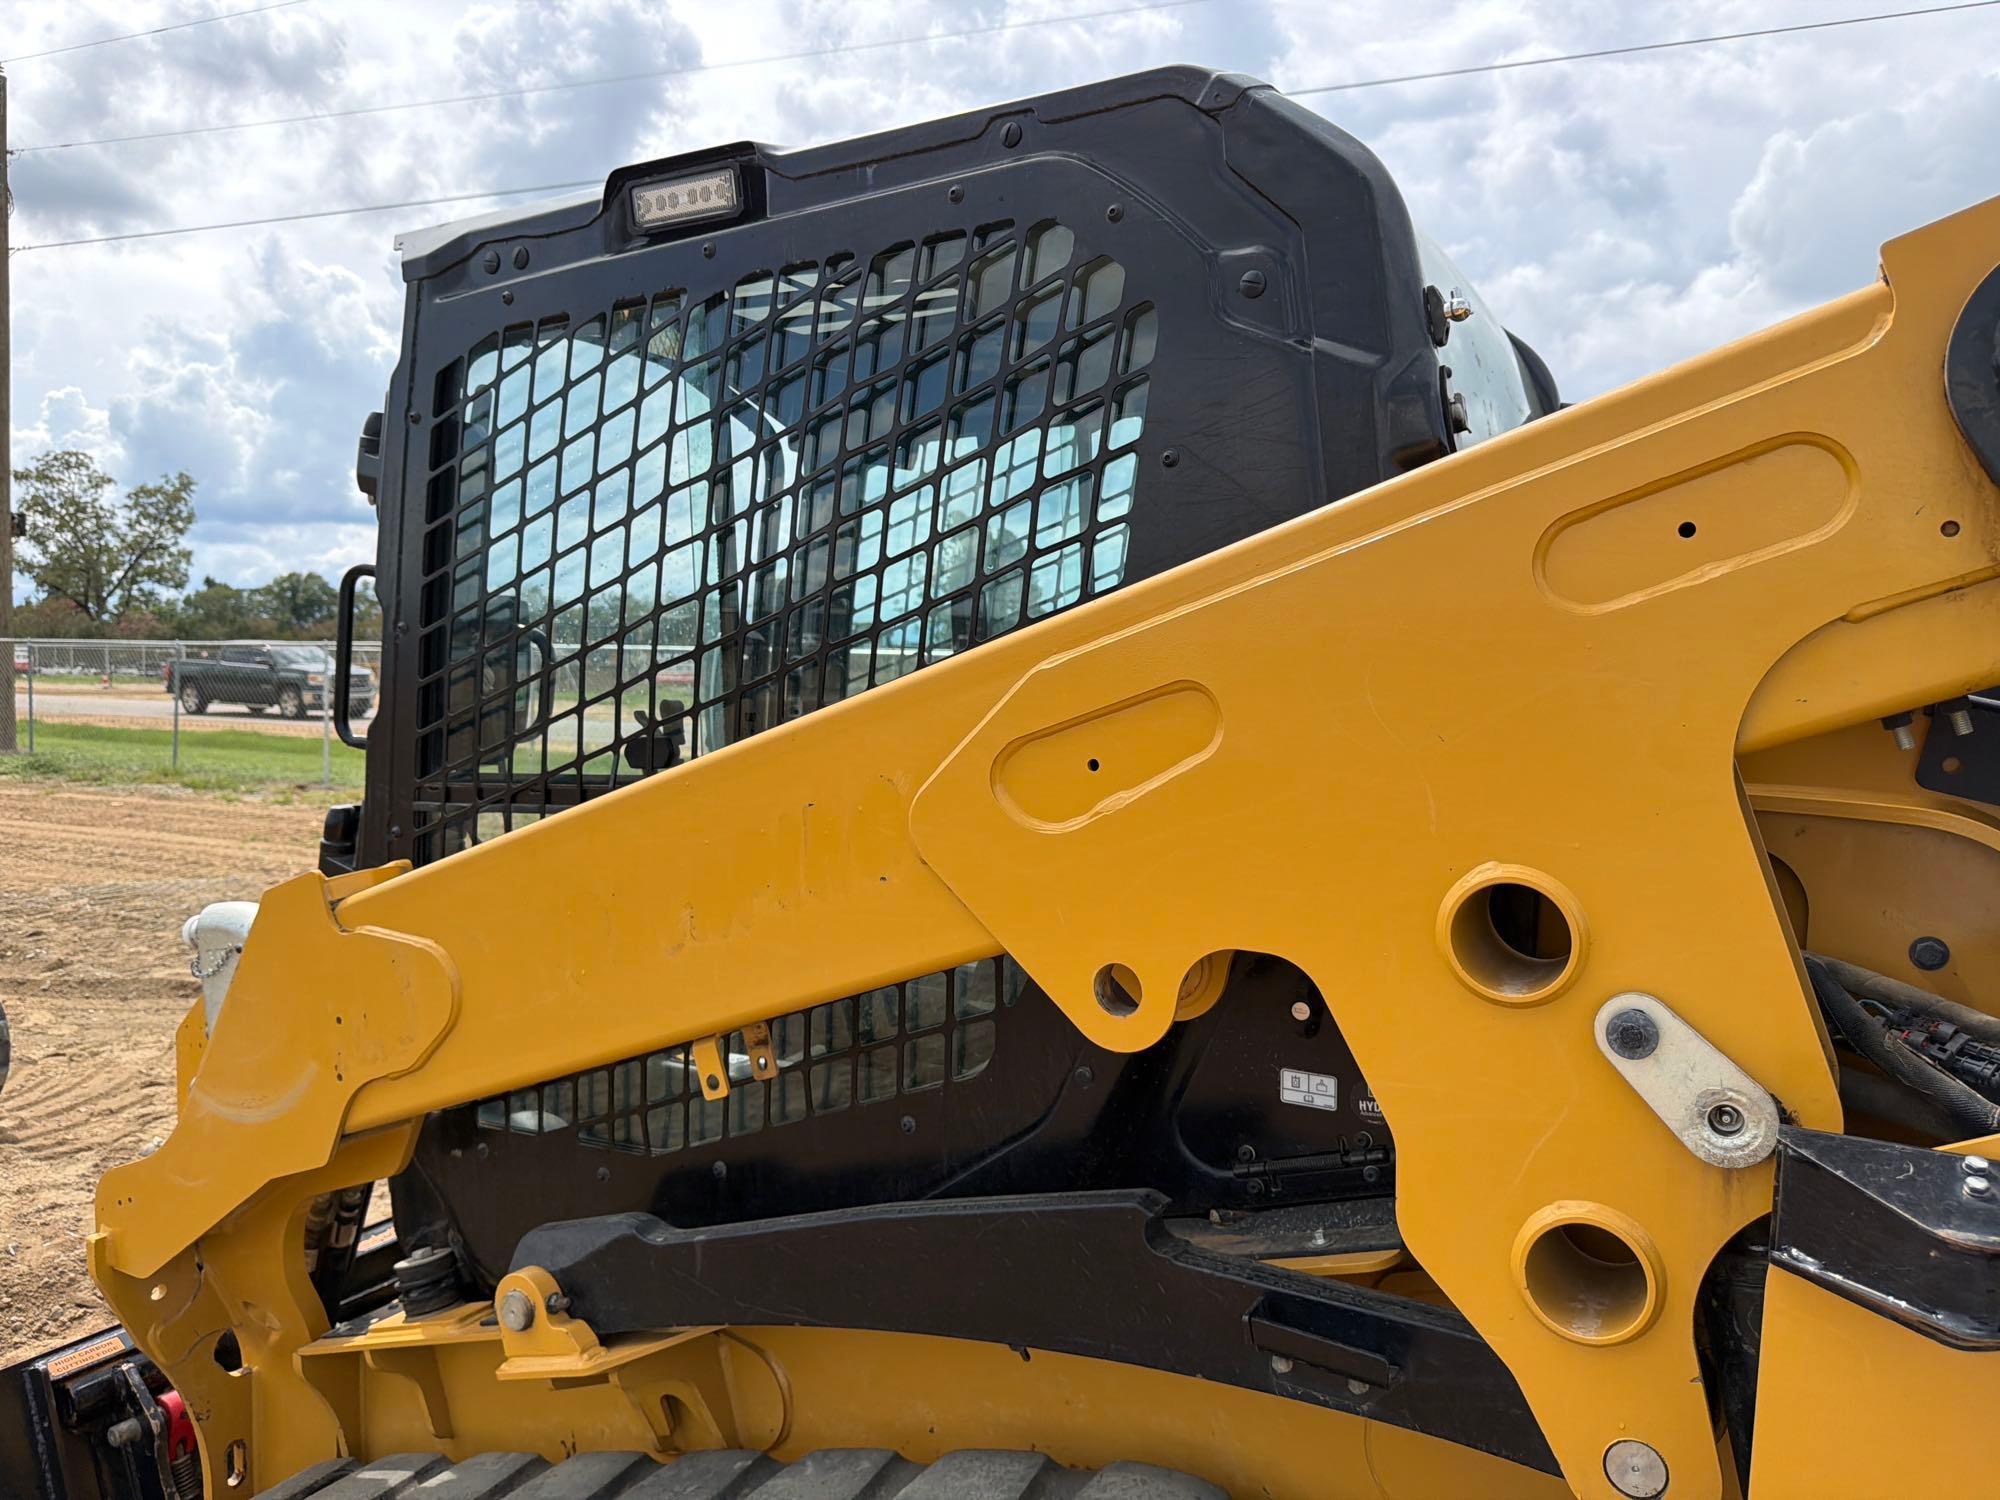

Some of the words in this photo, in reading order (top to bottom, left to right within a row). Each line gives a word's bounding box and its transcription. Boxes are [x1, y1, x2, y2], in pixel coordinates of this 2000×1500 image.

[54, 1355, 76, 1366] HIGH
[78, 1341, 113, 1357] CARBON
[56, 1355, 95, 1373] CUTTING
